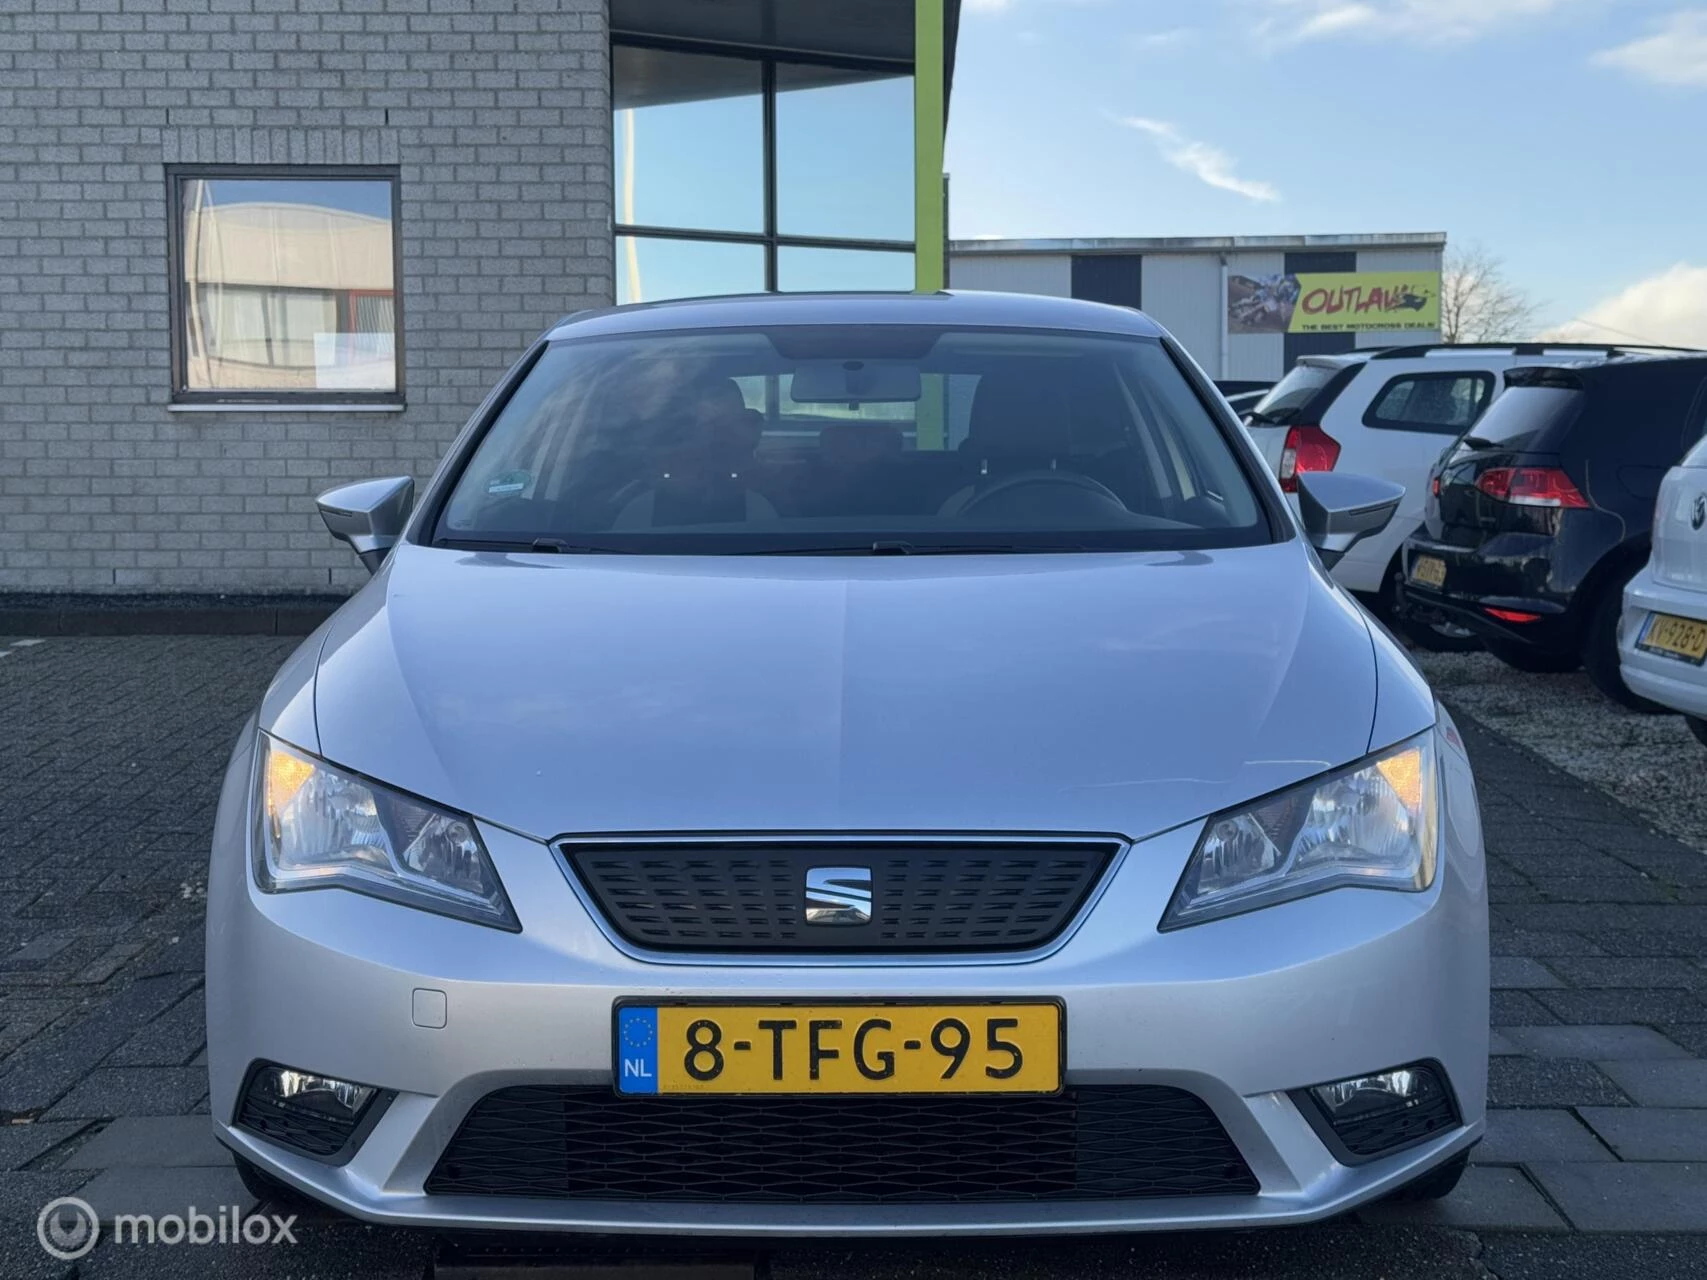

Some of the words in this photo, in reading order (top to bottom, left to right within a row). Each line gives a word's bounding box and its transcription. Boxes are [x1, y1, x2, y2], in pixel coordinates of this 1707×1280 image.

[1301, 323, 1318, 331] THE
[1320, 323, 1344, 331] BEST
[1346, 322, 1402, 330] MOTOCROSS
[684, 1018, 1024, 1081] 8-TFG-95
[624, 1059, 652, 1078] NL
